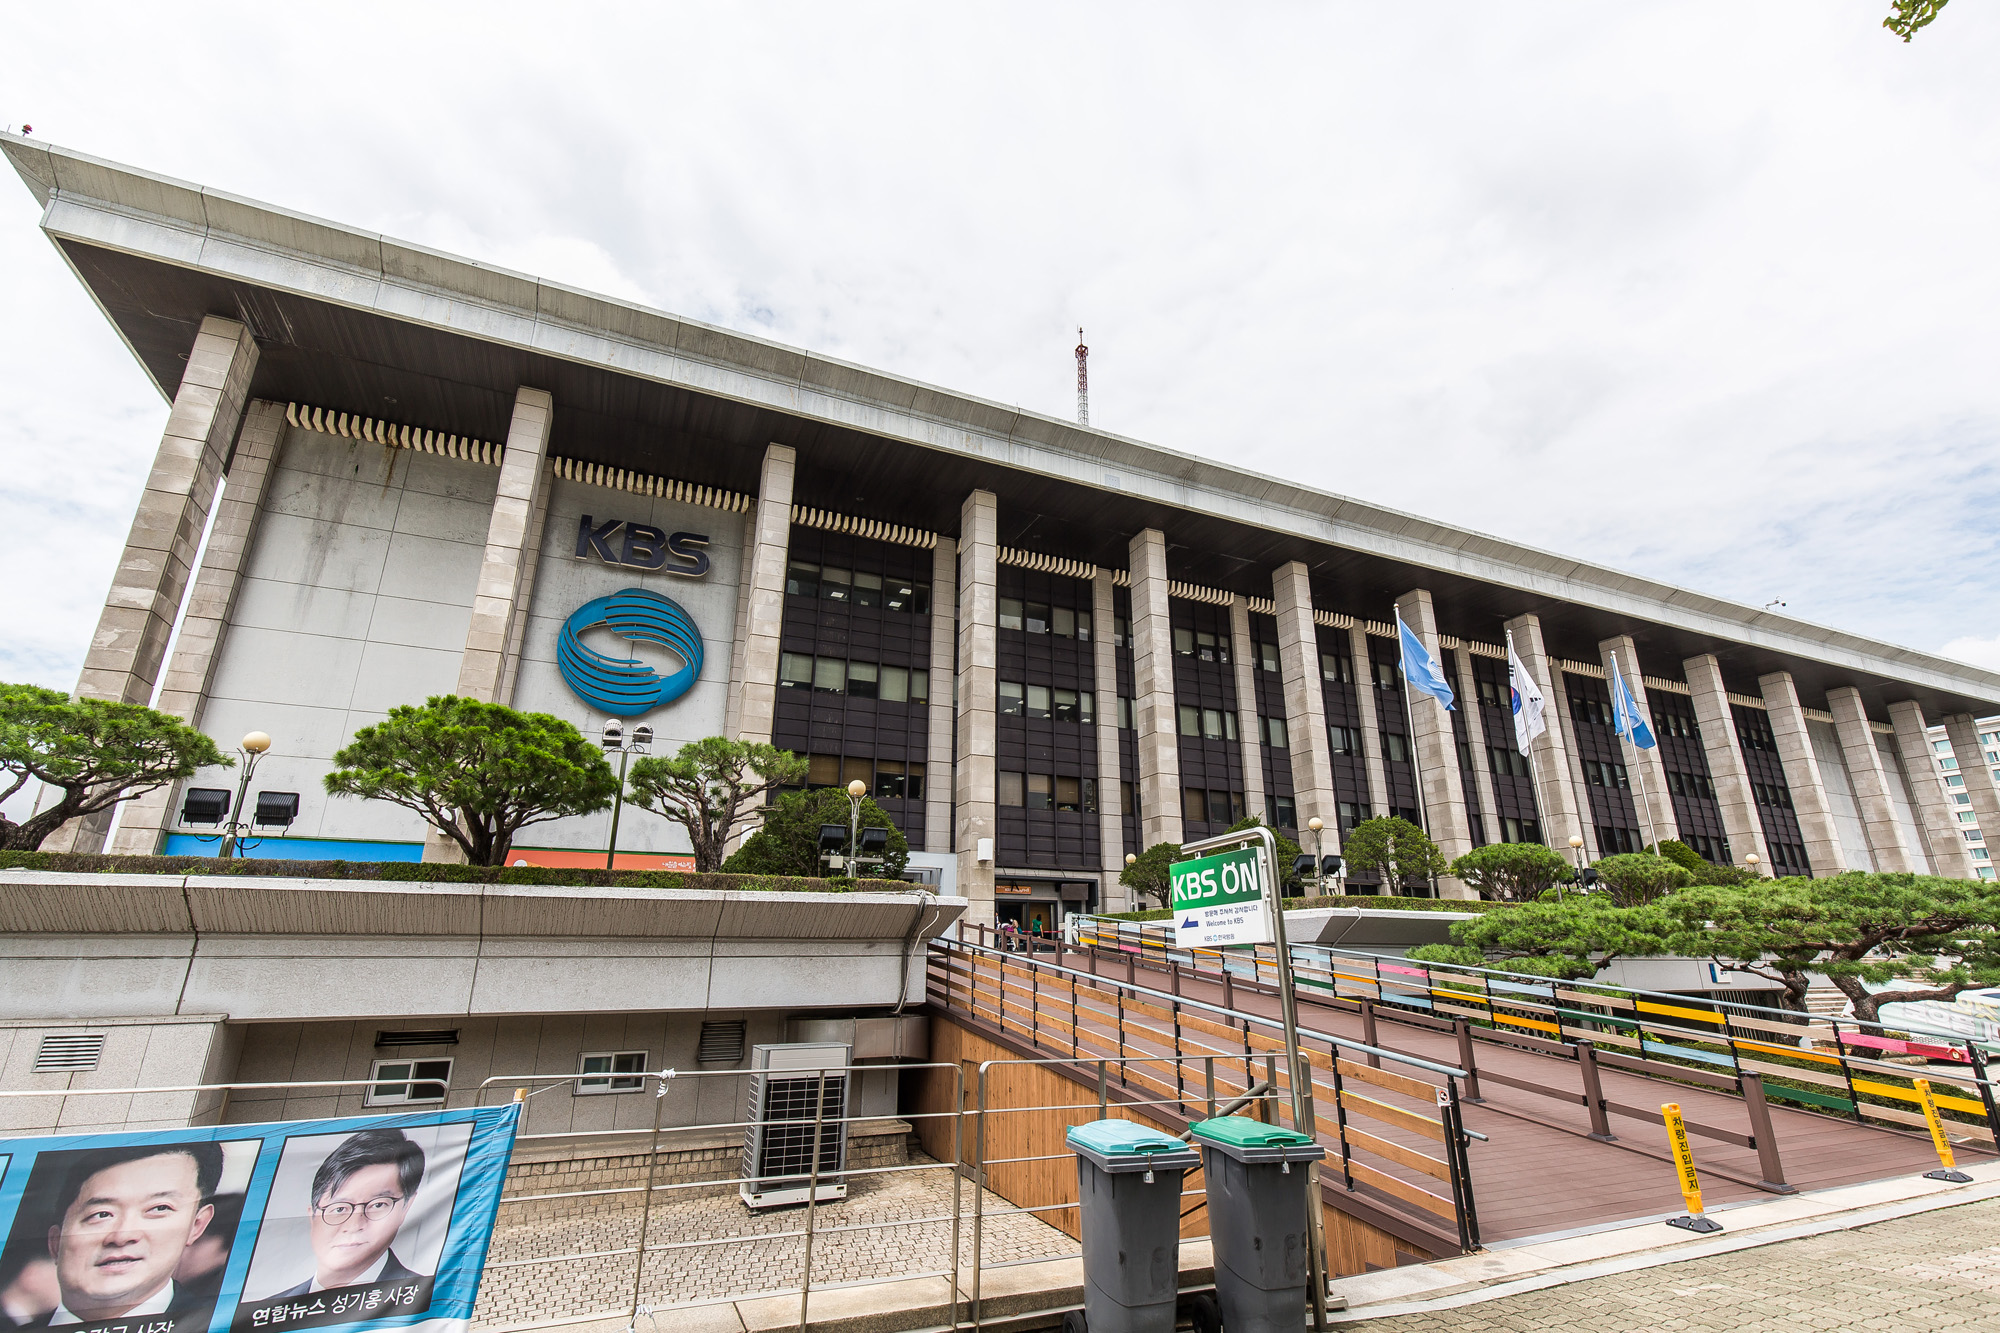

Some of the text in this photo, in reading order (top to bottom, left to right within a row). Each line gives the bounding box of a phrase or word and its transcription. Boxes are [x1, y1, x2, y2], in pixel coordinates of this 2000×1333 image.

[575, 514, 710, 577] KBS
[1172, 868, 1218, 902] KBS
[1234, 904, 1258, 914] 감사합니다
[1925, 1088, 1949, 1148] 차량진입금지
[1673, 1116, 1698, 1189] 차량진입금지
[252, 1284, 420, 1327] 연합뉴스 성기홍 사장
